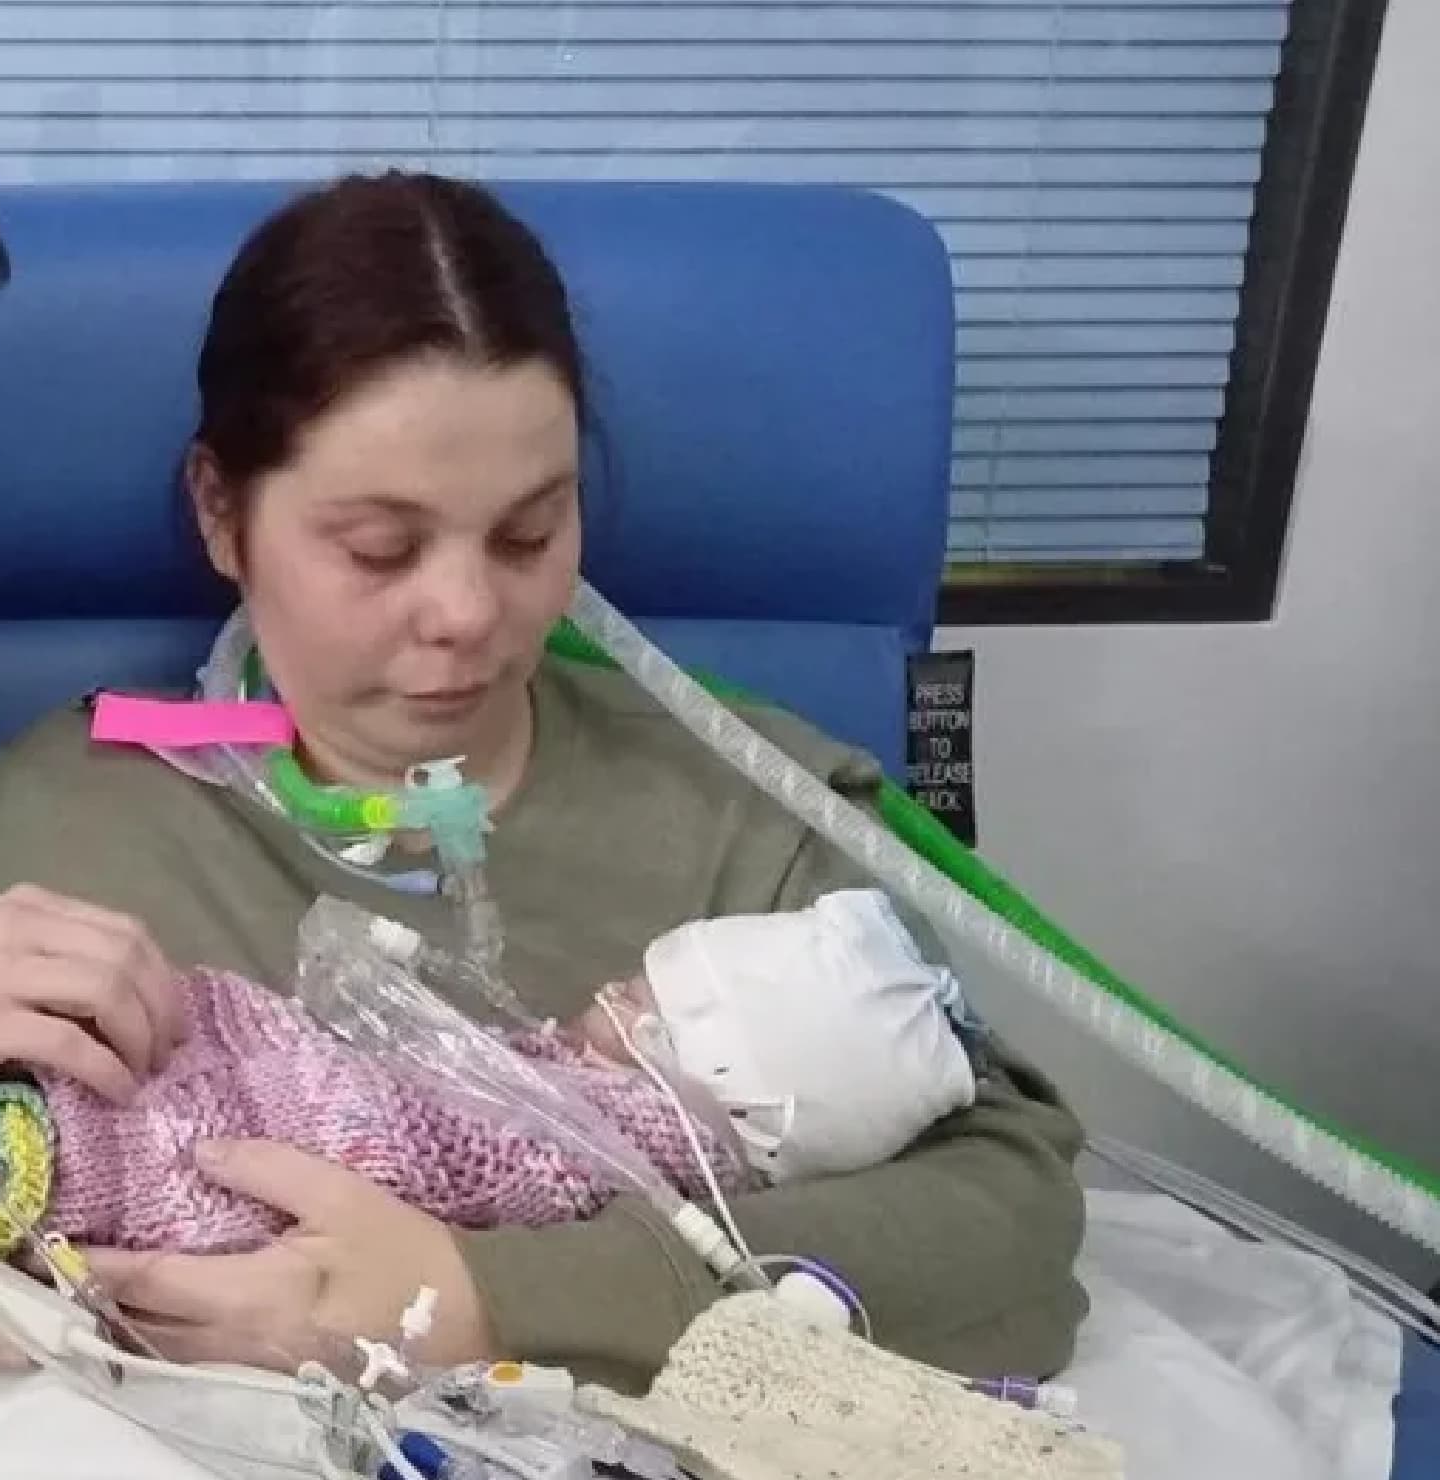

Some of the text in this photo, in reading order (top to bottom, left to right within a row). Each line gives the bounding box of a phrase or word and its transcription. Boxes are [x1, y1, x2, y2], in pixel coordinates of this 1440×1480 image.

[916, 684, 964, 705] PRESS
[909, 711, 969, 731] BUTTON
[929, 737, 951, 759] TO
